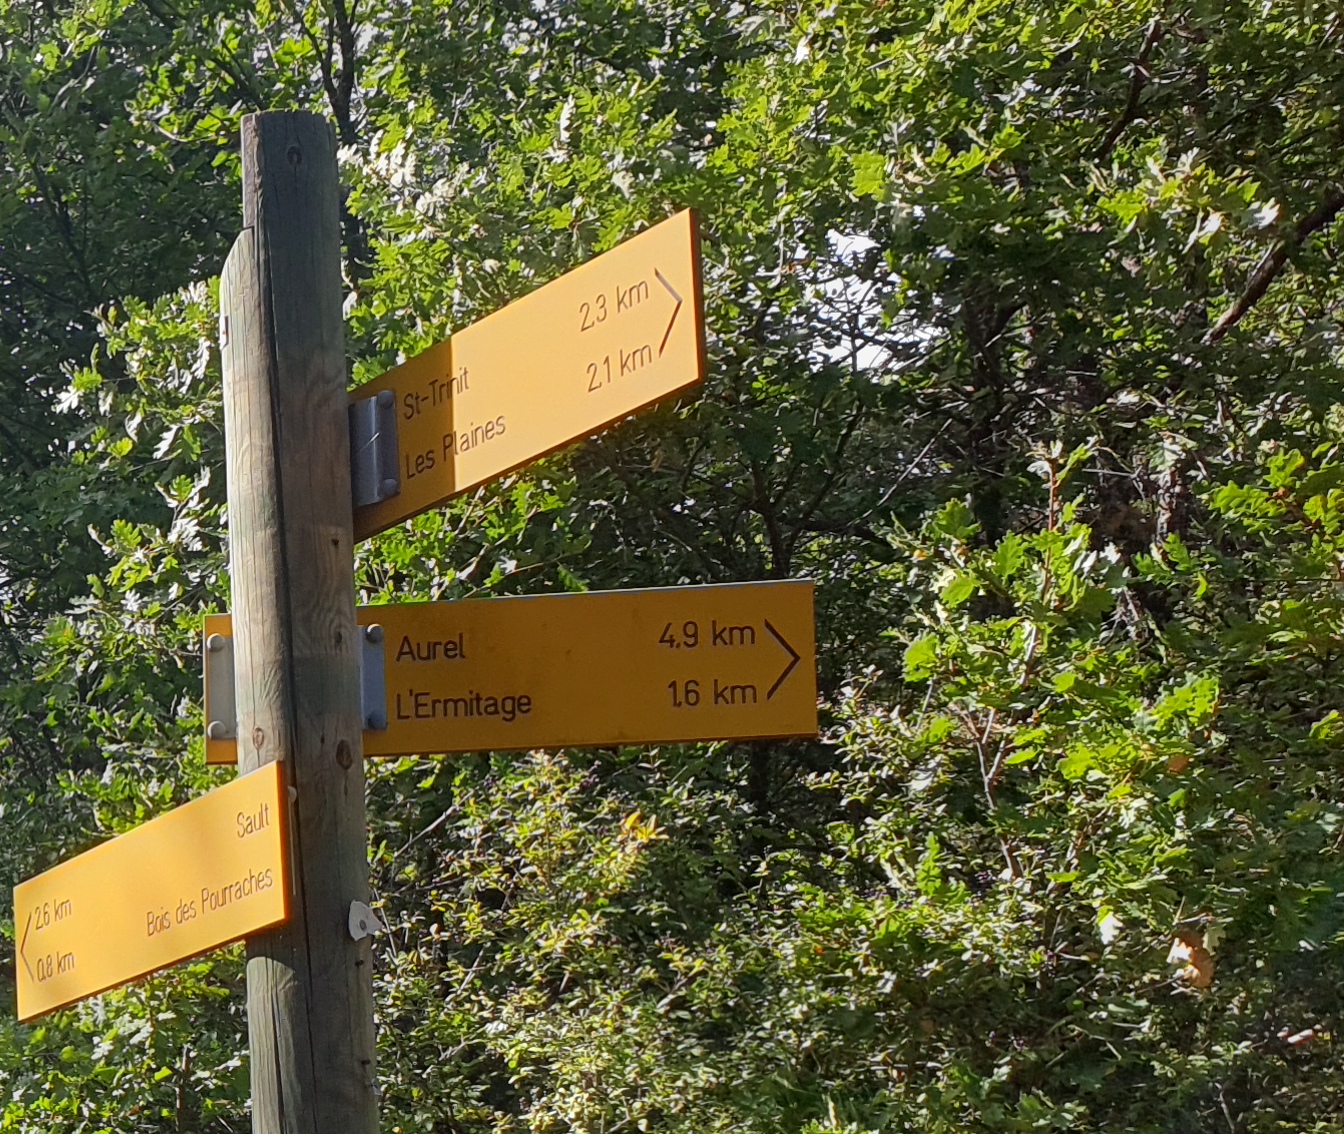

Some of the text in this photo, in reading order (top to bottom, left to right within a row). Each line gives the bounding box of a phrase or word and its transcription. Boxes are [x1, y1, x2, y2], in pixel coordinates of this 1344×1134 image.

[616, 280, 649, 314] km
[619, 344, 652, 377] km
[404, 367, 470, 420] St-Trinit
[406, 415, 506, 480] Les Plaines
[396, 632, 466, 662] Aurel
[658, 619, 756, 649] 4.9 km
[396, 688, 532, 722] L'Ermitage
[713, 678, 757, 705] km
[236, 802, 270, 839] Sault
[53, 898, 72, 922] km
[146, 867, 273, 937] Bois des Pourraches
[56, 951, 75, 976] km
